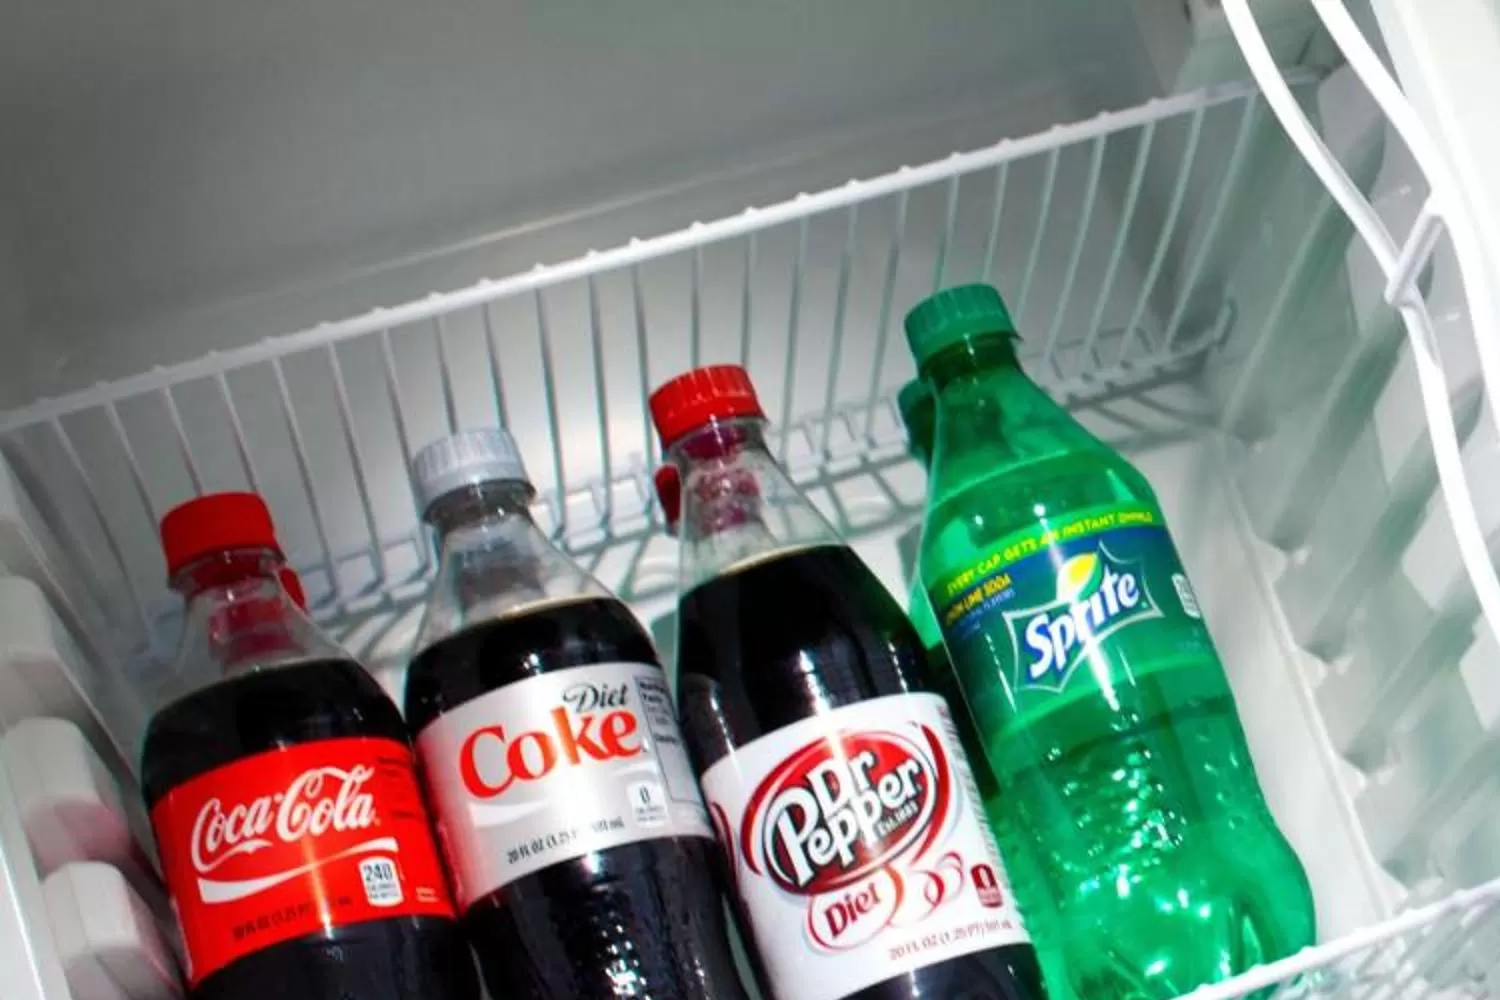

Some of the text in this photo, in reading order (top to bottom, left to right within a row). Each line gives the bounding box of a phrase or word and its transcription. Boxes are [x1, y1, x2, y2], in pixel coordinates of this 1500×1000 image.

[1024, 564, 1140, 679] Sprite
[562, 682, 628, 713] Diet
[459, 705, 642, 800] Coke
[805, 750, 875, 818] Dr
[191, 764, 376, 873] Coca-Cola
[768, 759, 920, 888] Pepper
[363, 863, 393, 883] 240
[824, 882, 882, 938] Diet
